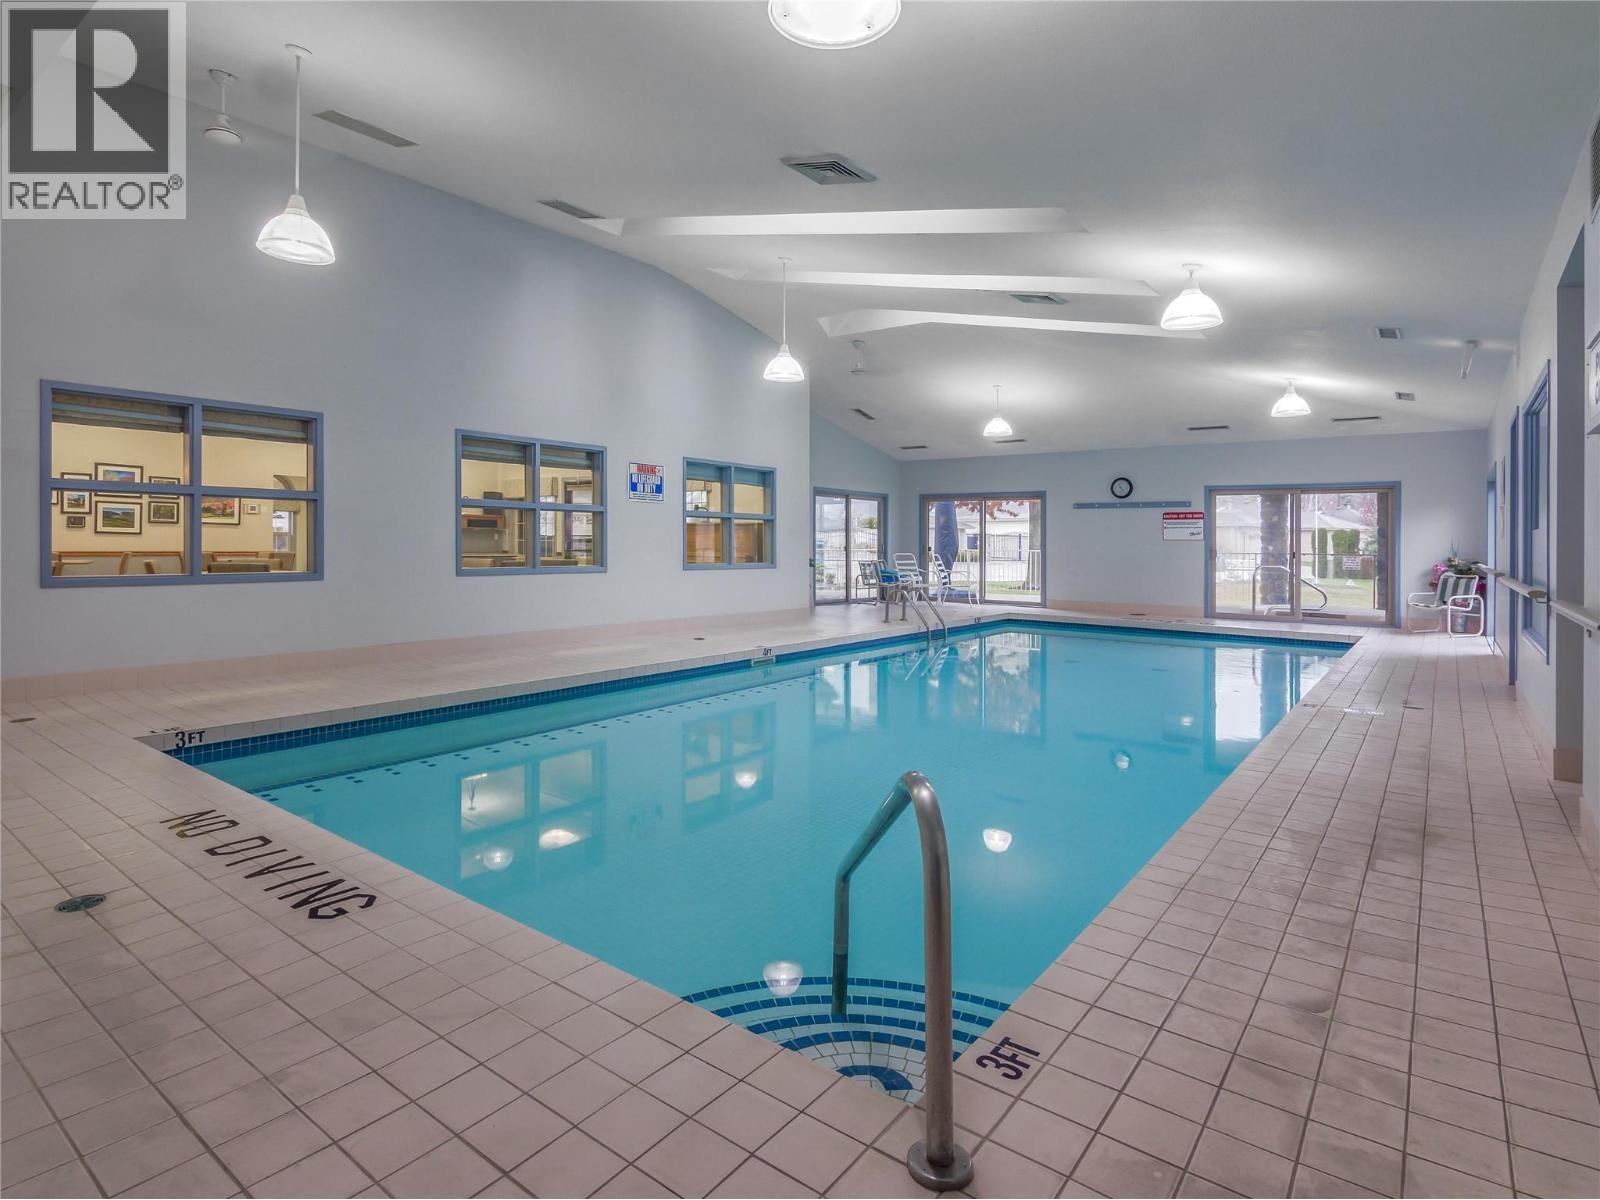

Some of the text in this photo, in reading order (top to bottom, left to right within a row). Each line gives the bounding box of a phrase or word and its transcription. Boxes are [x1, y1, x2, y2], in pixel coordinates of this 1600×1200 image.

[159, 809, 378, 920] NO DIVING
[975, 1036, 1041, 1080] 3FT
